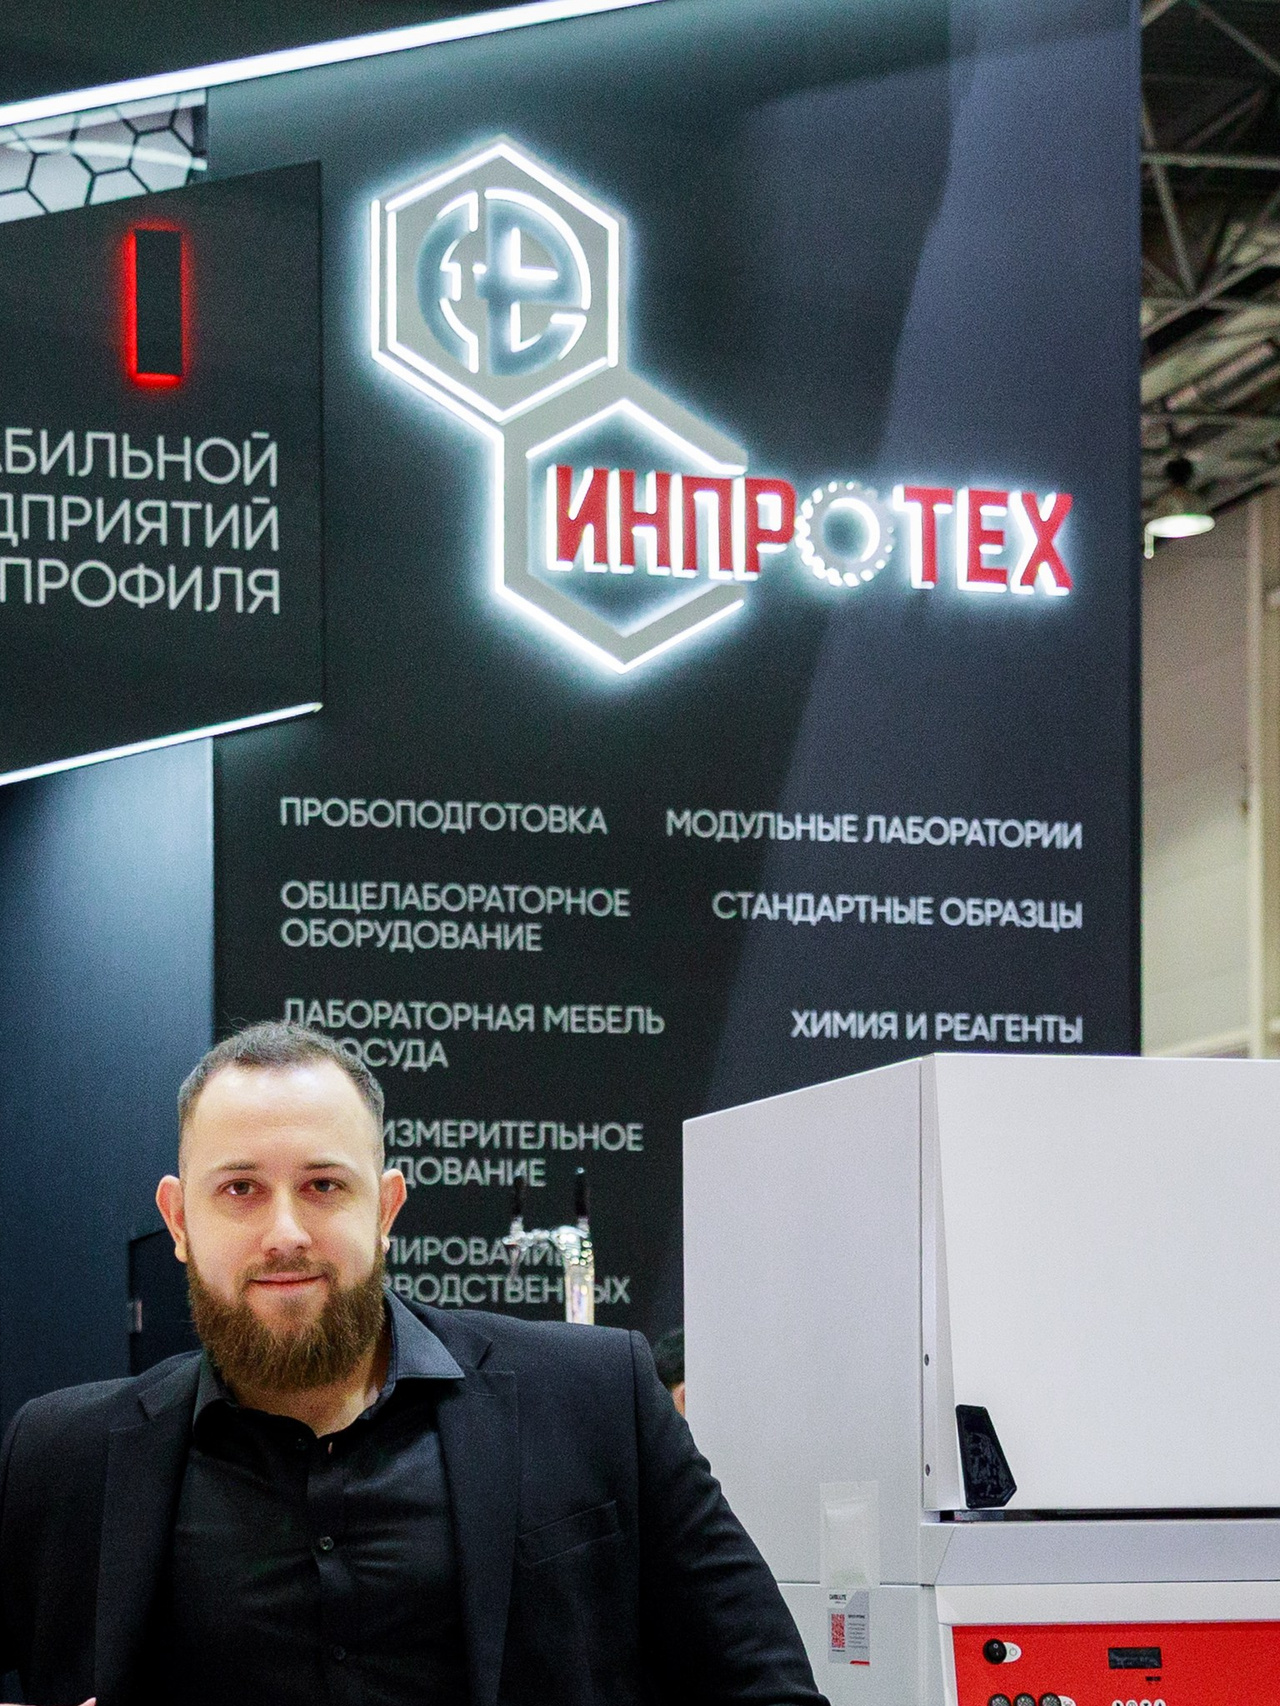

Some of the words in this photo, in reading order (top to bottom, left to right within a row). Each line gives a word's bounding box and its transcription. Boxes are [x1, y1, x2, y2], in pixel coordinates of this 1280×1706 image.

[280, 796, 608, 834] ПРОБОПОДГОТОВКА
[666, 809, 858, 844] МОДУЛЬНЫЕ
[862, 813, 1083, 849] ЛАБОРАТОРИИ
[280, 880, 630, 917] ОБЩЕЛАБОРАТОРНОЕ
[712, 891, 933, 927] СТАНДАРТНЫЕ
[940, 896, 1083, 933] ОБРАЗЦЫ
[280, 918, 542, 953] ОБОРУДОВАНИЕ
[284, 998, 535, 1032] ЛАБОРАТОРНАЯ
[544, 1004, 665, 1034] МЕБЕЛЬ
[790, 1009, 899, 1041] ХИМИЯ
[906, 1012, 925, 1041] И
[934, 1011, 1083, 1045] РЕАГЕНТЫ
[340, 1037, 448, 1074] ОСУДА
[384, 1118, 643, 1151] ИЗМЕРИТЕЛЬНОЕ
[384, 1155, 546, 1190] ДОВАНИЕ
